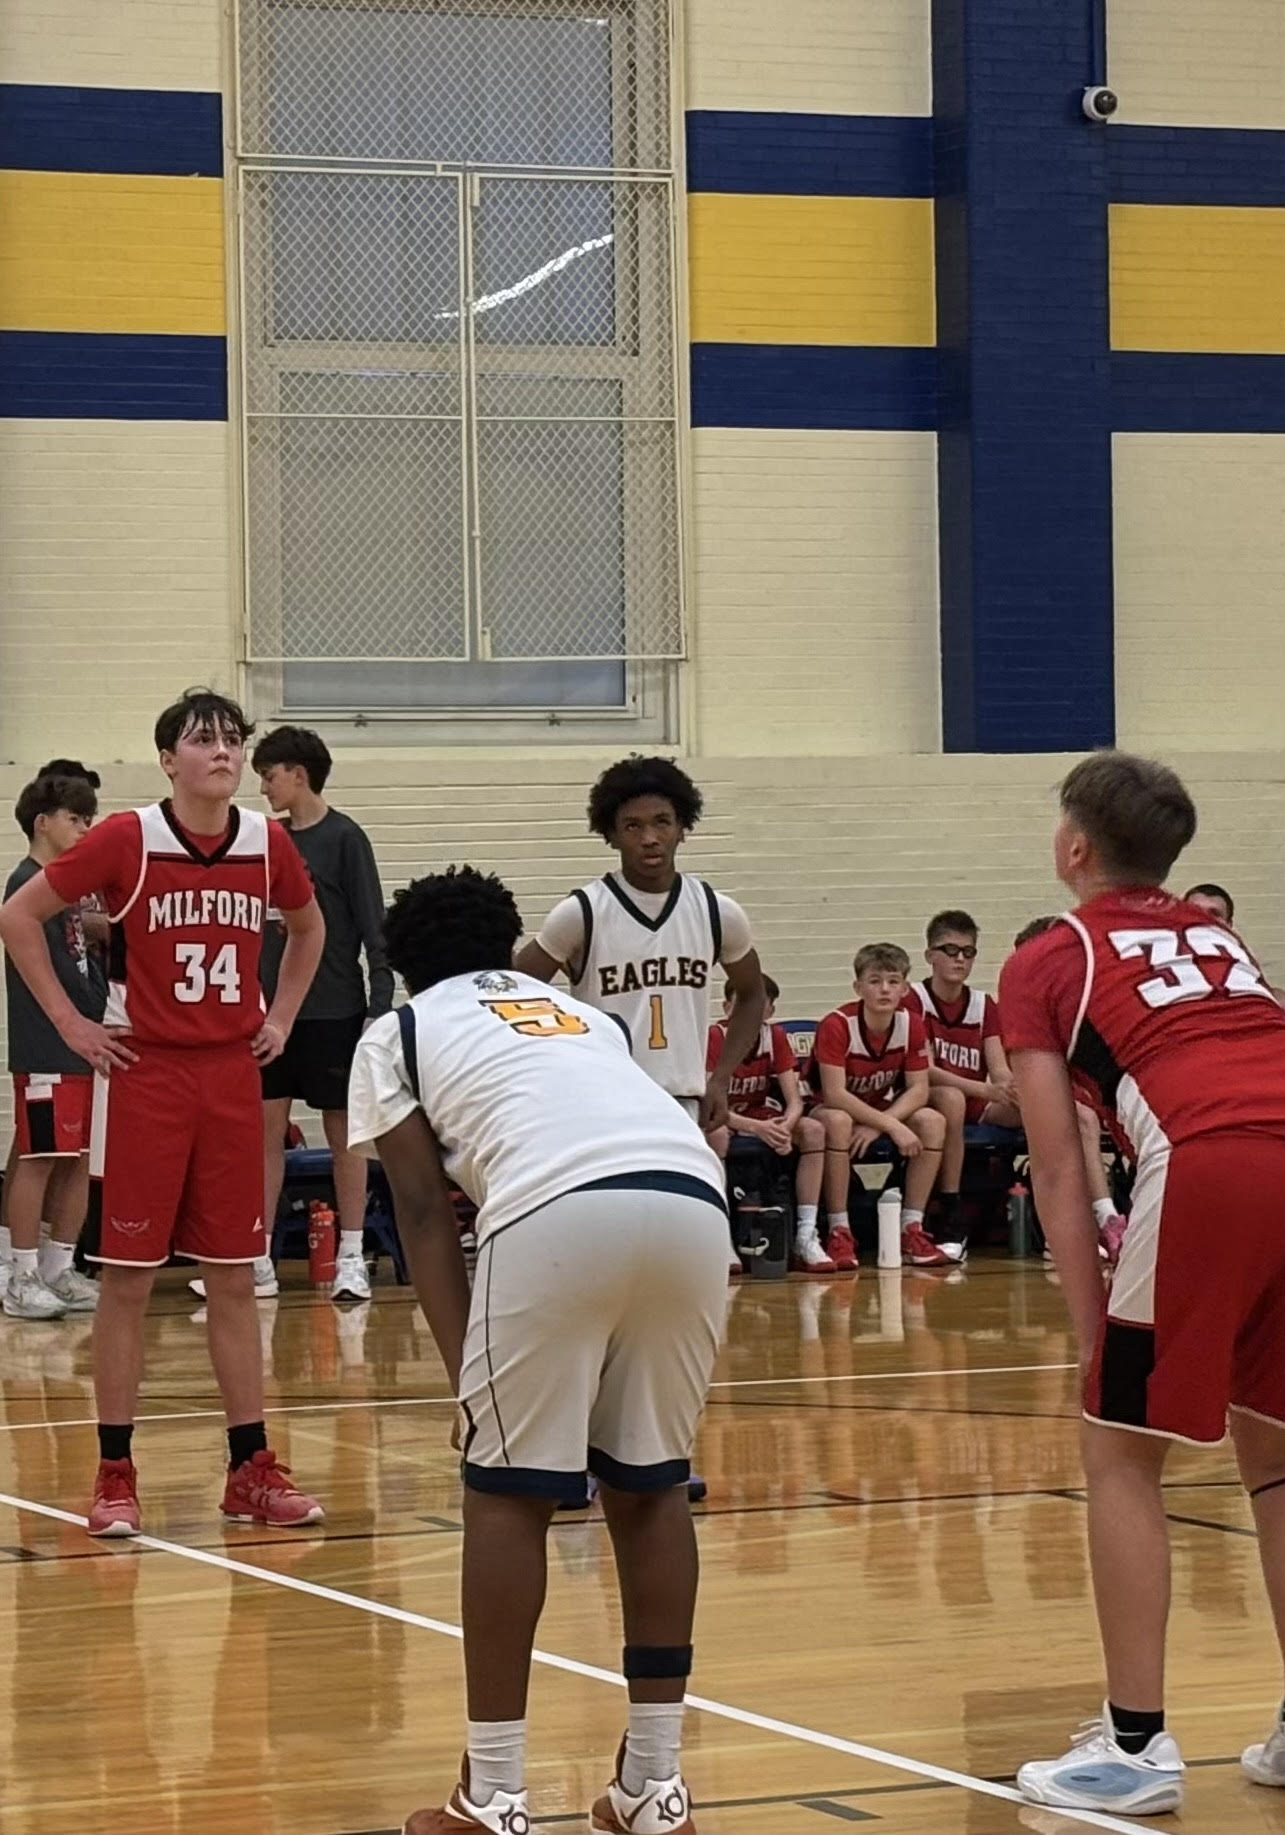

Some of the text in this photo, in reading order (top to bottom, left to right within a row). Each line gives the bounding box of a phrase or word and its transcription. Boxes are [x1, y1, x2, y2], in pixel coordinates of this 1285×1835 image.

[148, 889, 262, 934] MILFORD
[174, 943, 241, 1004] 34
[598, 956, 709, 997] EAGLES
[1106, 923, 1282, 1010] 32
[477, 996, 591, 1038] 5
[648, 994, 668, 1050] 1
